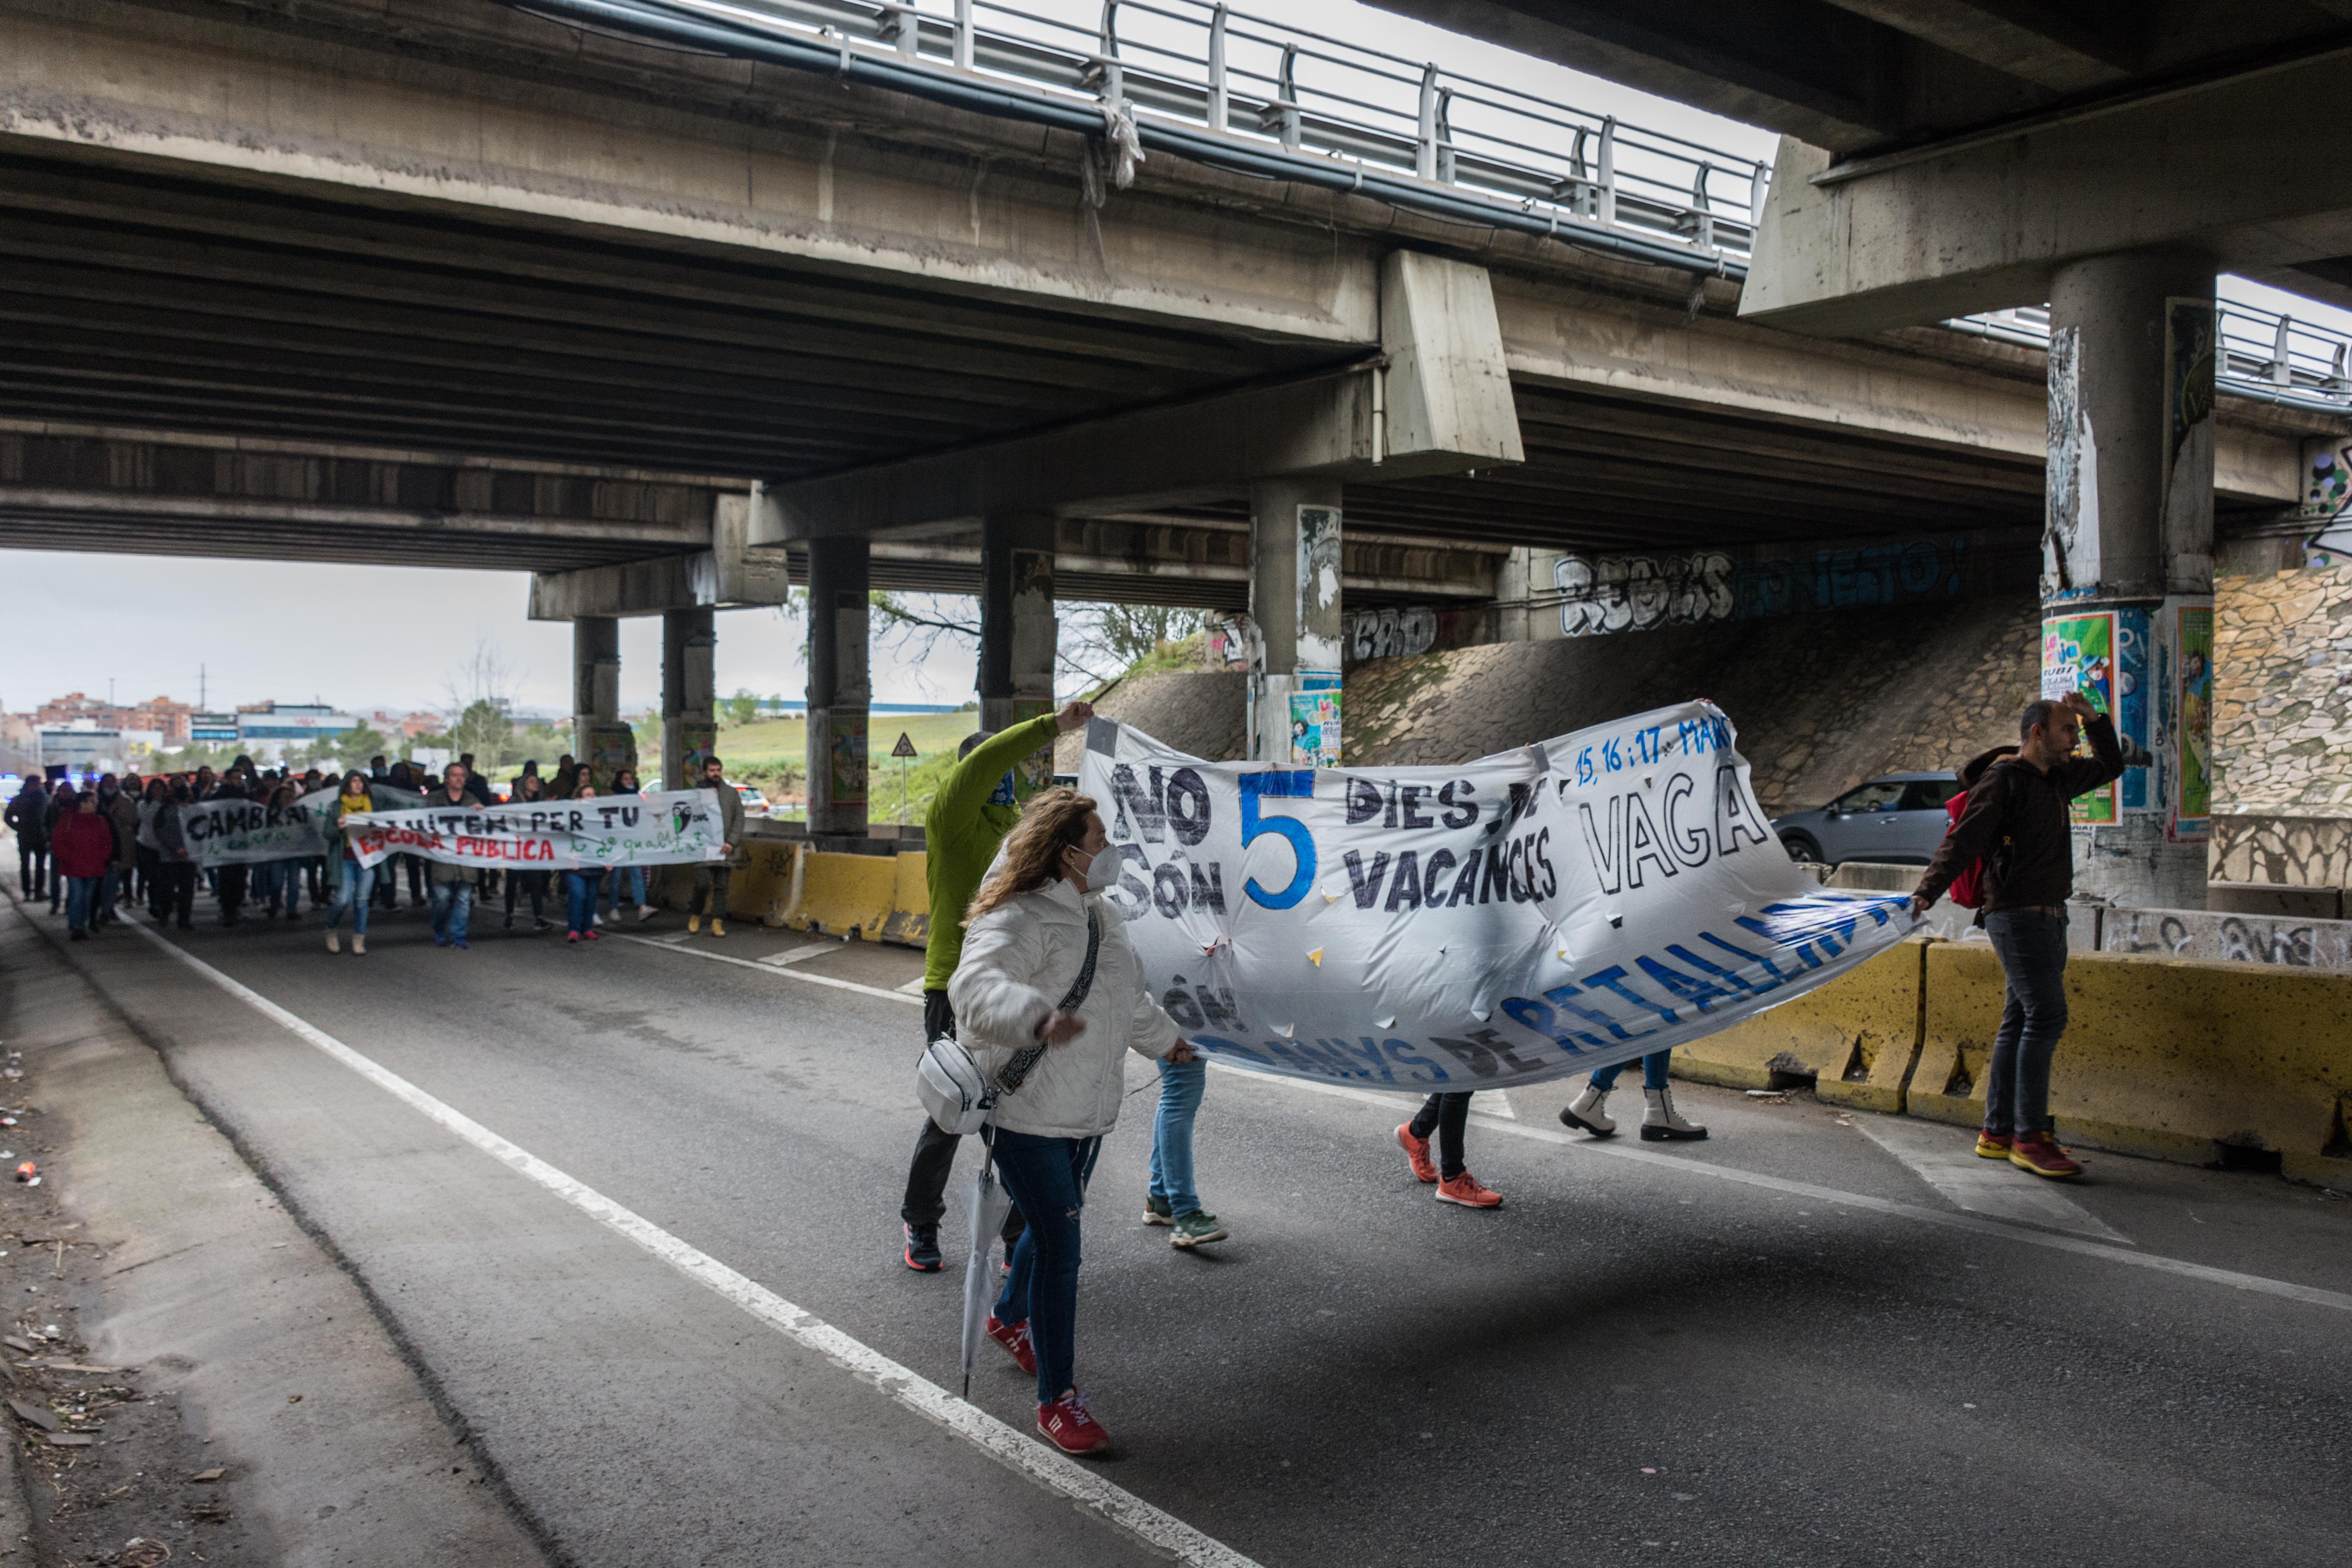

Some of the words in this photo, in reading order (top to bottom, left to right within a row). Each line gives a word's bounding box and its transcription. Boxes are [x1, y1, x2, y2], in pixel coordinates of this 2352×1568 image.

[1602, 736, 1622, 773] 16
[1635, 726, 1660, 764] 17
[531, 810, 584, 833] PER
[598, 806, 639, 829] TU
[1111, 763, 1212, 846] NO
[1345, 777, 1480, 830] DIES
[1579, 765, 1768, 895] VAGA
[358, 829, 444, 855] ESCOLA
[1238, 769, 1318, 910] 5
[1343, 826, 1557, 913] VACANCES
[1163, 973, 1249, 1033] ÓN
[1428, 1028, 1547, 1079] DE
